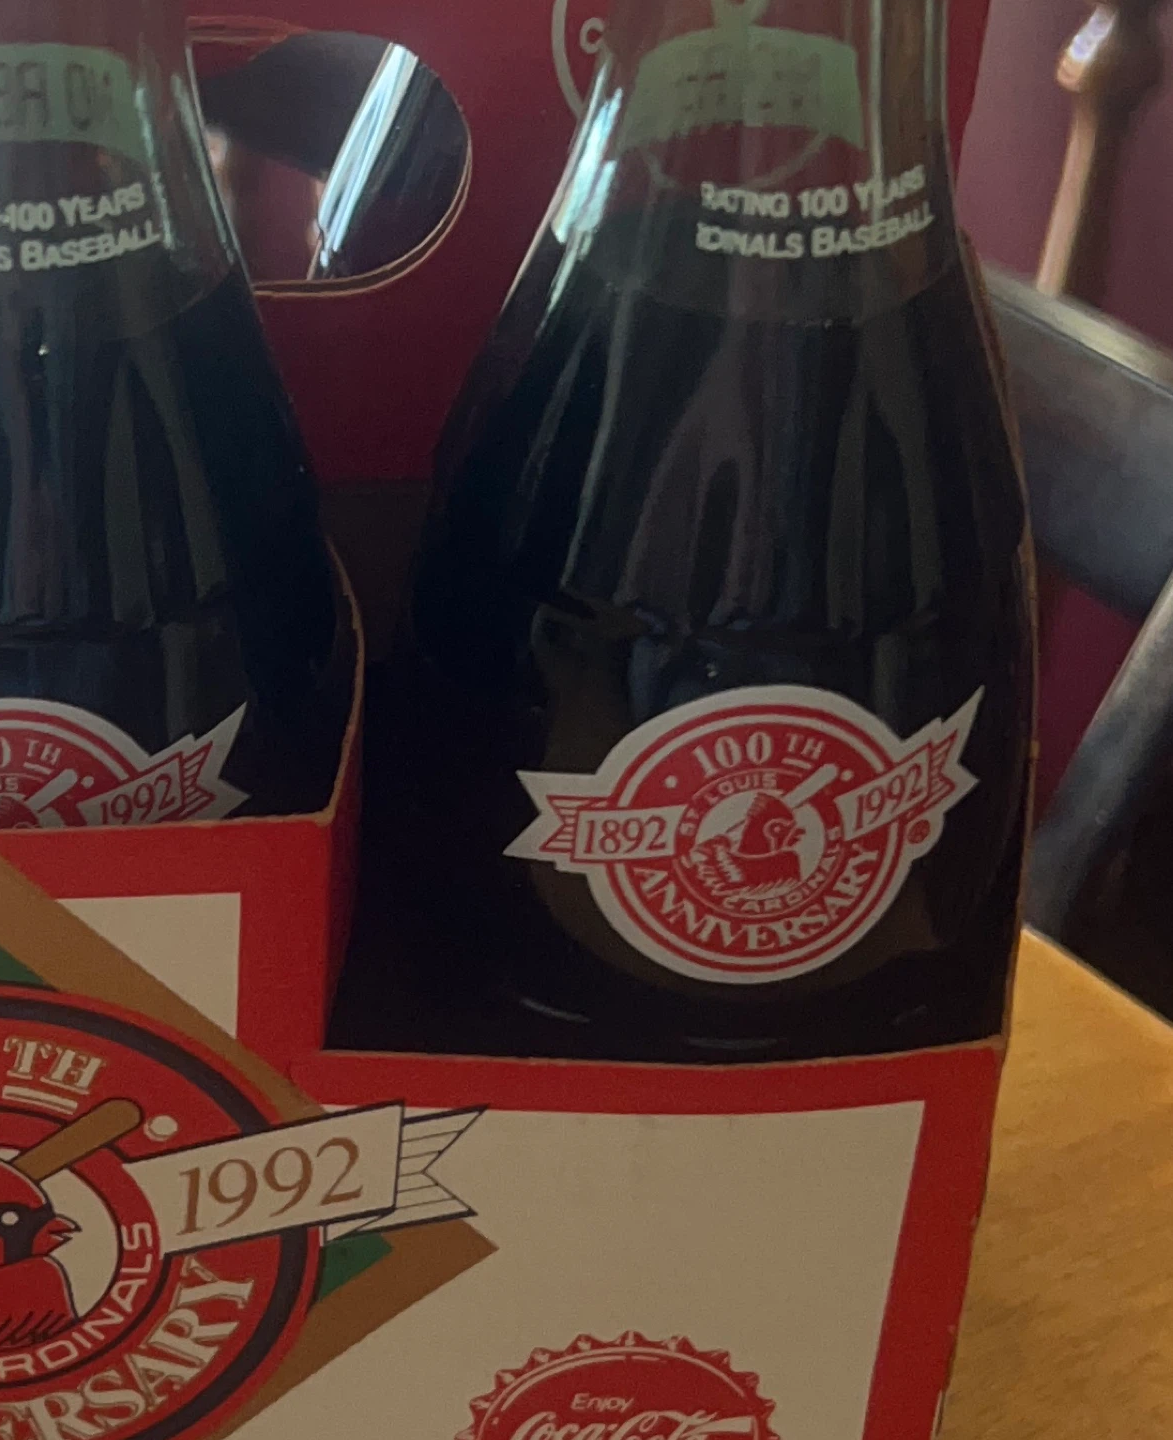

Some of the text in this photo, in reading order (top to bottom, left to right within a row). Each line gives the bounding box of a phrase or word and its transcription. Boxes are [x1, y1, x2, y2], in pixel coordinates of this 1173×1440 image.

[4, 201, 55, 233] 100
[57, 181, 146, 227] YEARS
[797, 186, 849, 219] 100
[810, 200, 936, 259] BASEBALL
[19, 218, 162, 272] BASEBALL
[690, 730, 773, 780] 100
[98, 771, 173, 827] 1992
[702, 771, 777, 806] LOUIS
[854, 760, 924, 831] 1992
[582, 814, 667, 856] 1892
[633, 843, 879, 952] ANNIVERSARY
[2, 1035, 107, 1095] TH
[173, 1136, 366, 1238] 1992
[570, 1392, 634, 1412] Enjoy
